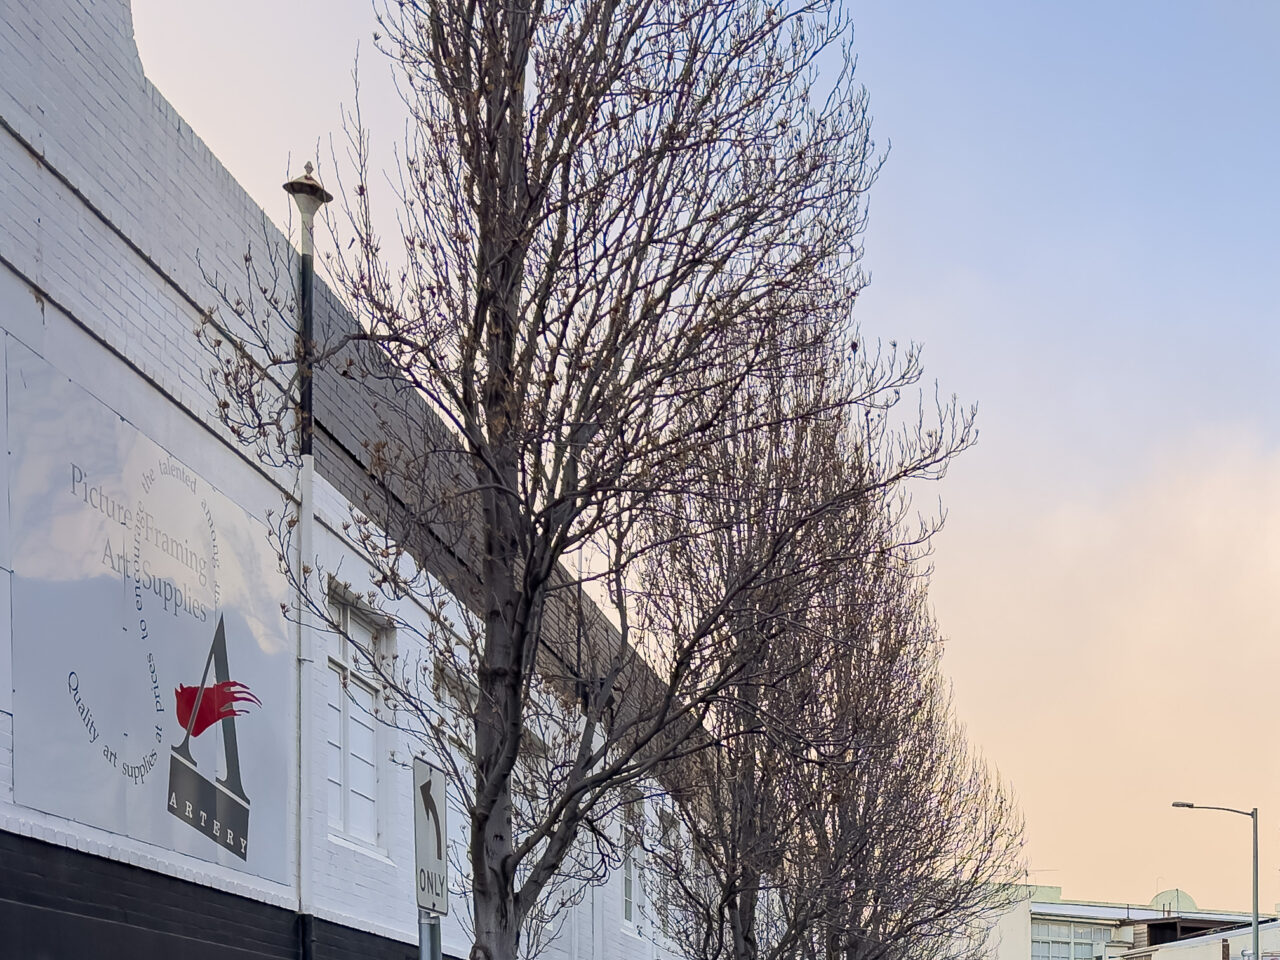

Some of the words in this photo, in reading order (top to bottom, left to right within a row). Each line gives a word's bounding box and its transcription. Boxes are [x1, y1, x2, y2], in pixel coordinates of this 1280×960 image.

[141, 468, 155, 494] the
[158, 459, 197, 495] talented
[70, 462, 132, 530] Picture
[144, 511, 207, 587] Framing
[102, 537, 130, 579] Art
[142, 560, 207, 623] Supplies
[139, 619, 148, 640] to
[68, 671, 99, 744] Quality
[103, 744, 118, 768] art
[122, 748, 158, 785] supplies
[169, 791, 247, 854] ARTERY
[419, 868, 445, 898] ONLY
